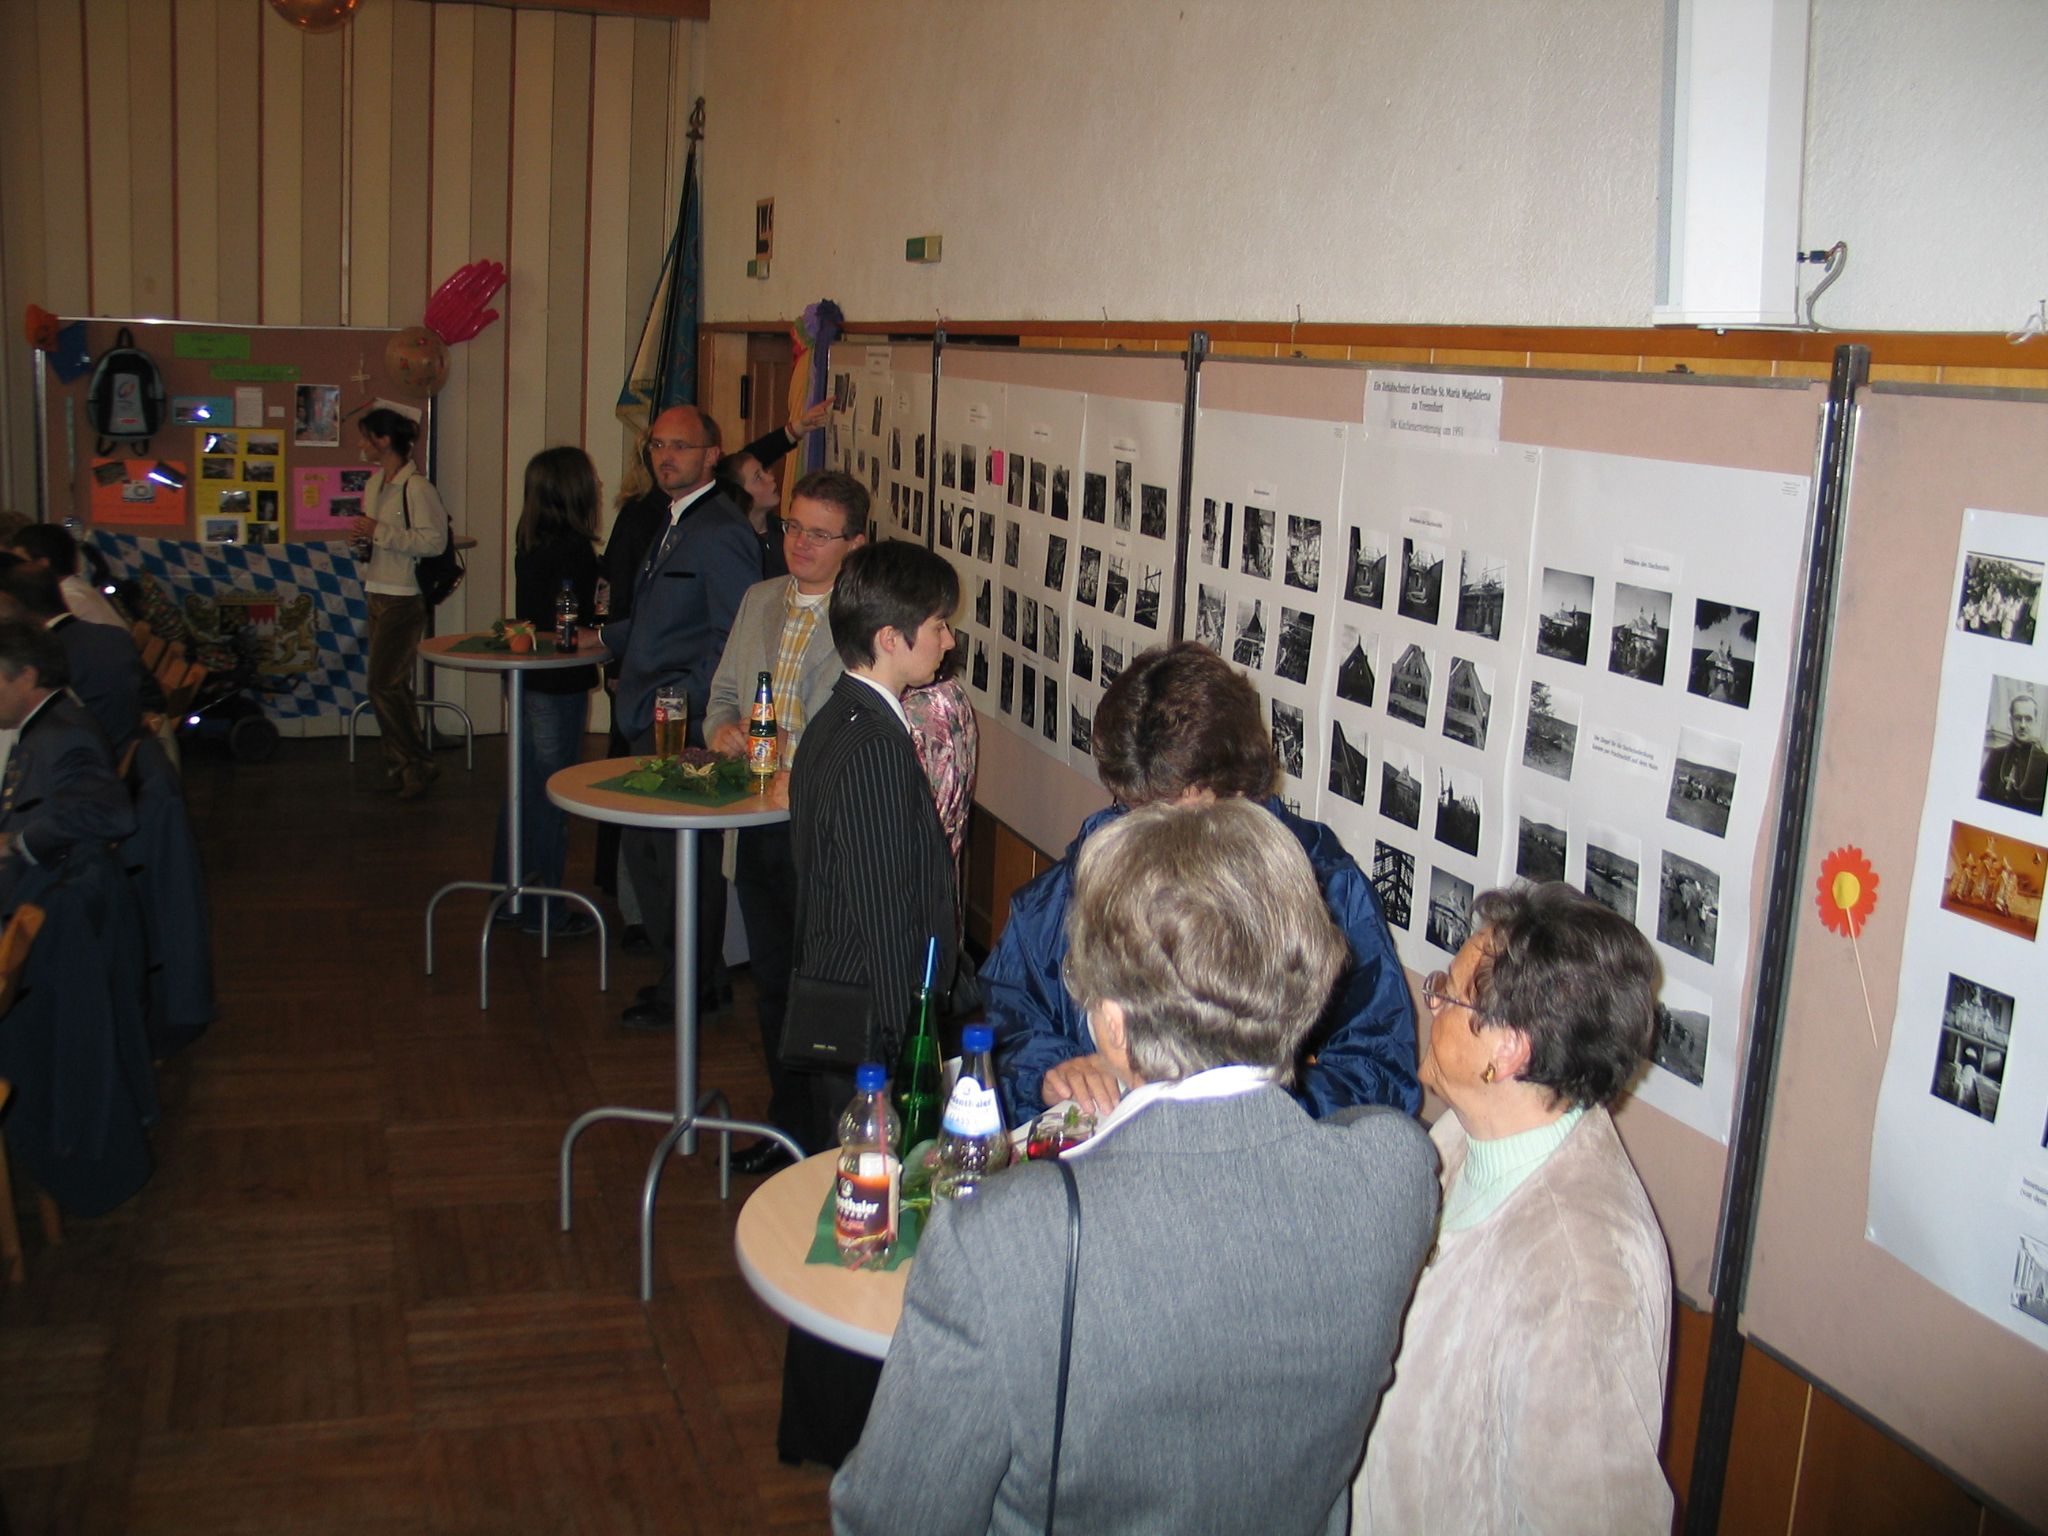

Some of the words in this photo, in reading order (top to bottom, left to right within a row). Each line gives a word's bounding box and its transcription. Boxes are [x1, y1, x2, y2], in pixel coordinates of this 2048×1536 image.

[1373, 381, 1381, 391] Ein
[1411, 384, 1420, 395] der
[1421, 385, 1437, 397] Kirche
[1446, 387, 1460, 398] Maria
[1461, 388, 1491, 402] Magdalena
